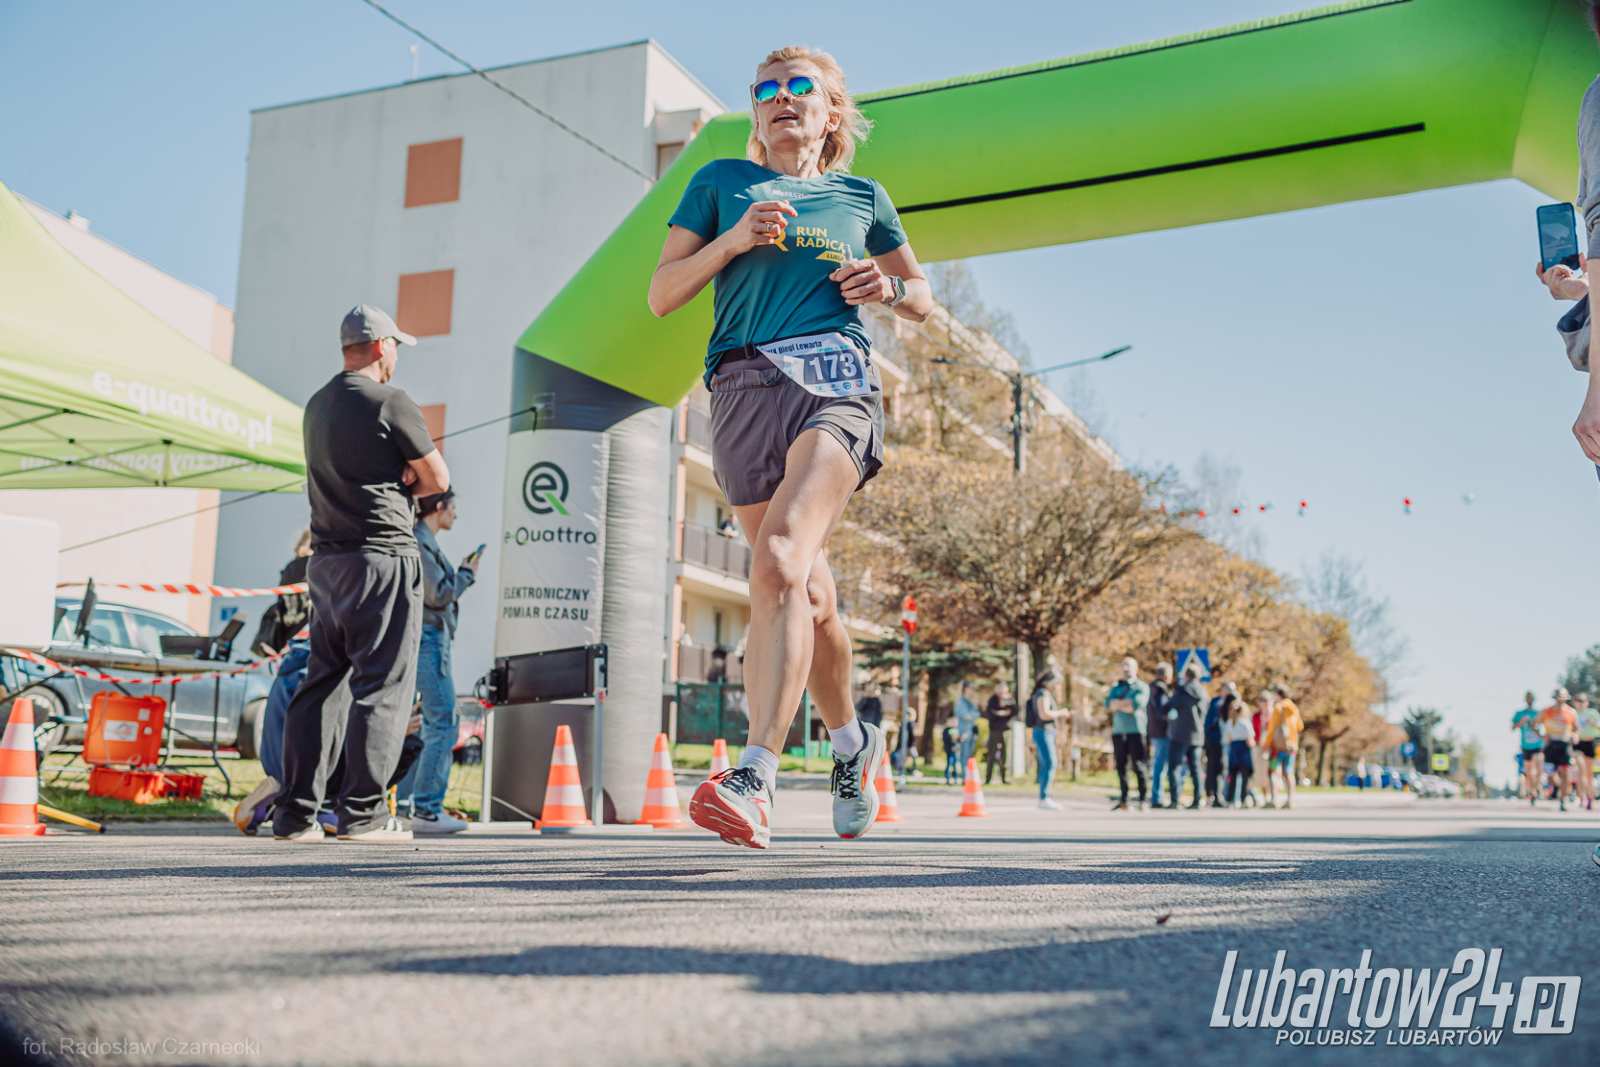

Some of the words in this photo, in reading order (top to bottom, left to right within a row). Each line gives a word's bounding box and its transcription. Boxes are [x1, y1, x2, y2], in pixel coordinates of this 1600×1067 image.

[796, 226, 828, 238] RUN
[796, 237, 847, 251] RADICA
[809, 352, 857, 380] 173
[92, 370, 273, 448] e-quattro.pl
[504, 586, 590, 601] ELEKTRONICZNY
[503, 606, 540, 619] POMIAR
[544, 606, 589, 621] CZASU
